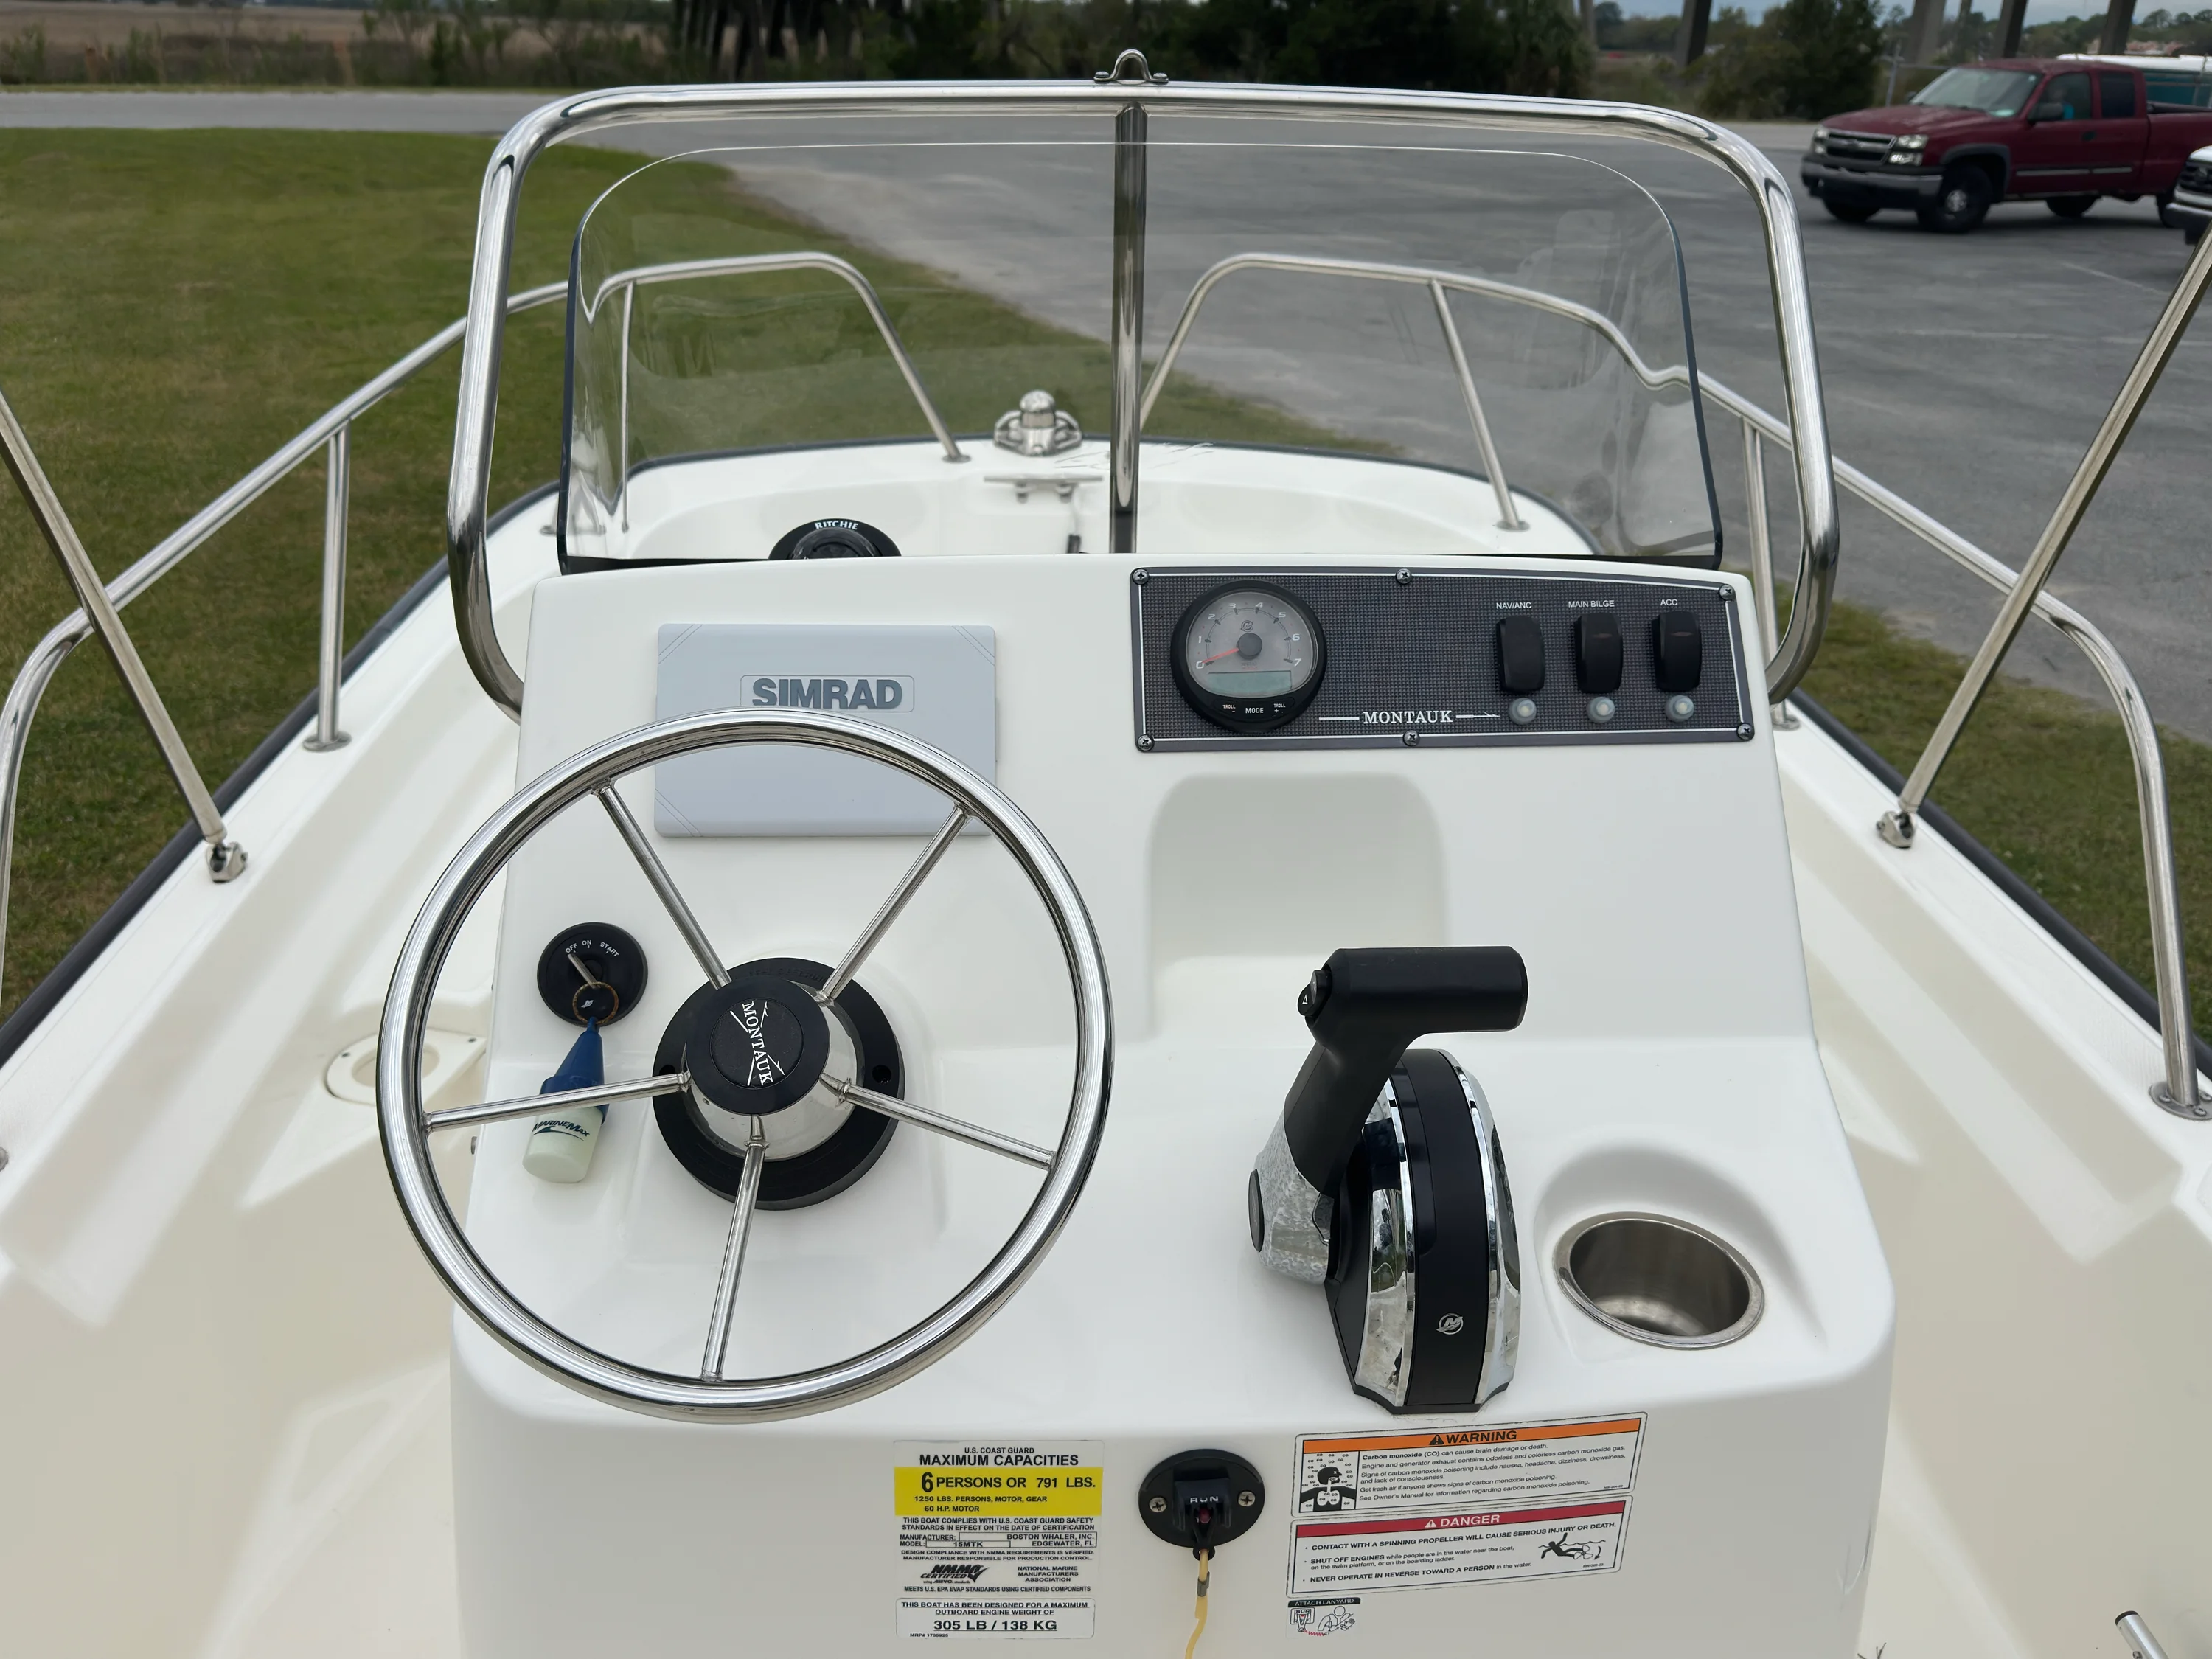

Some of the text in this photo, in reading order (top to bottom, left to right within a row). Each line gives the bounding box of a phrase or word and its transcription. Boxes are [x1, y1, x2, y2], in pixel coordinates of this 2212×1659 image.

[814, 520, 858, 531] RITCHIE
[1496, 602, 1532, 610] NAV/ANC
[1568, 600, 1588, 608] MAIN
[1198, 636, 1202, 644] 1
[1195, 661, 1205, 669] 0
[1293, 658, 1301, 667] 7
[752, 678, 902, 709] SIMRAD
[1363, 711, 1453, 724] MONTAUK
[565, 942, 577, 954] OFF
[600, 942, 619, 958] START
[742, 1001, 773, 1085] MONTAUK
[1446, 1430, 1517, 1444] WARNING
[1492, 1445, 1519, 1453] damage
[919, 1455, 1078, 1466] MAXIMUM CAPACITIES
[922, 1472, 1095, 1492] 6 PERSONS OR 791 LBS.
[1440, 1514, 1500, 1527] DANGER
[1311, 1543, 1349, 1551] CONTACT
[1379, 1538, 1416, 1546] SPINNING
[1418, 1535, 1463, 1543] PROPELLER
[933, 1621, 1057, 1630] 305 LB / 138 KG
